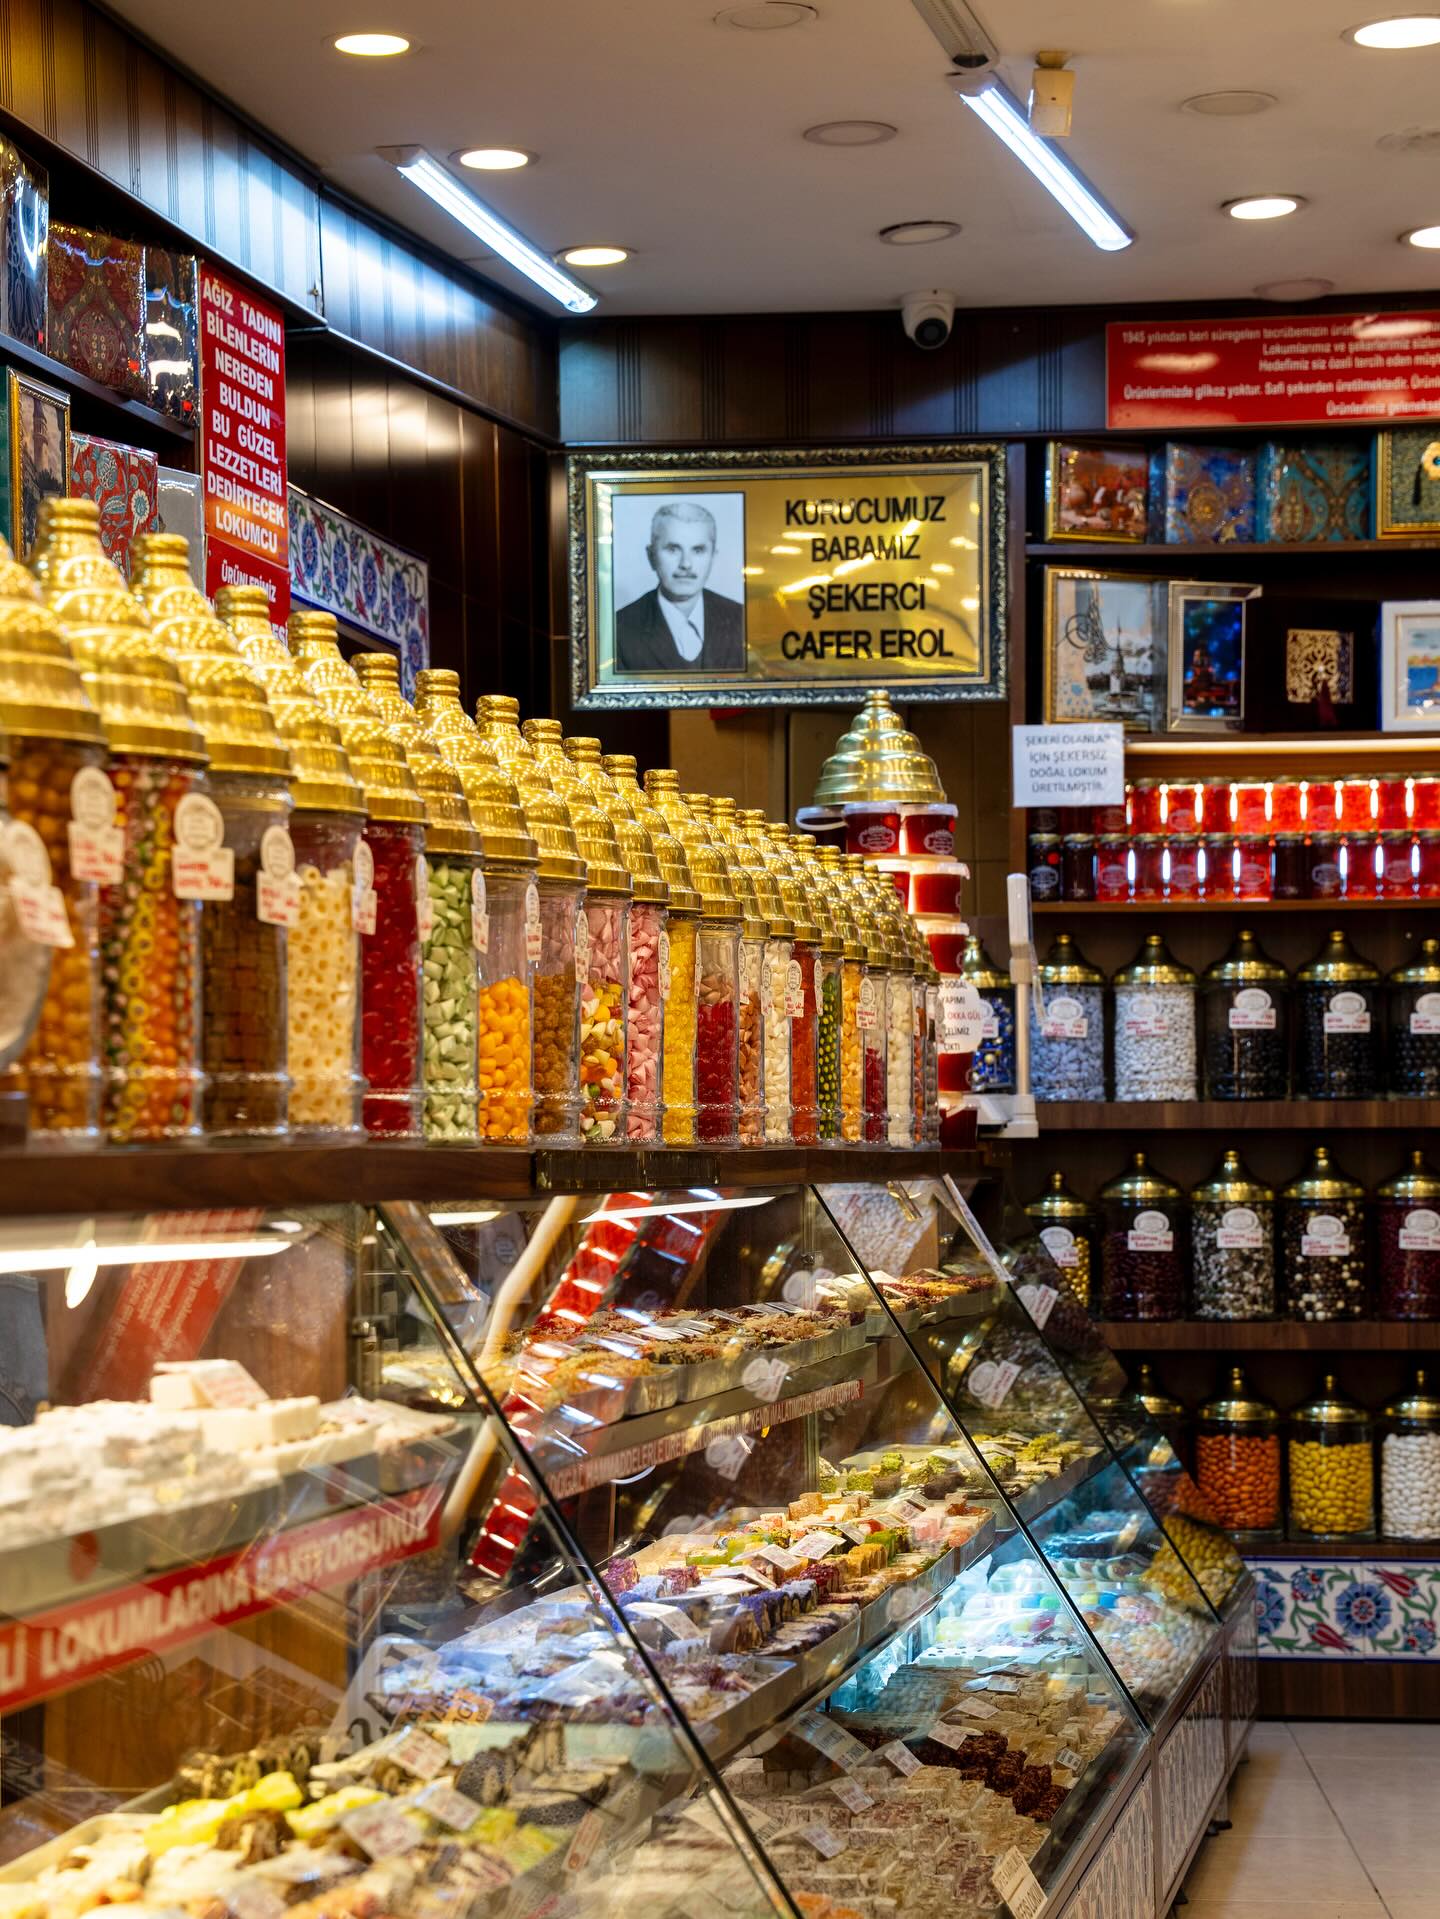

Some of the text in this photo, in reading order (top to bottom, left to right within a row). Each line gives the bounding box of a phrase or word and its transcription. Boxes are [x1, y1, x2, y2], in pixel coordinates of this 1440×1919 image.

[203, 277, 281, 346] AĞIZ TADINI
[206, 310, 280, 375] BİLENLERİN
[215, 347, 273, 401] NEREDEN
[220, 381, 271, 430] BULDUN
[212, 409, 279, 464] BU GÜZEL
[208, 438, 282, 497] LEZZETLERİ
[207, 470, 286, 528] DEDİRTECEK
[785, 496, 946, 526] KURUCUMUZ
[215, 505, 278, 553] LOKUMCU
[811, 534, 920, 562] BABAMIZ
[808, 575, 926, 619] ŞEKERCİ
[781, 628, 954, 660] CAFER EROL
[1029, 750, 1050, 764] İÇİN
[1030, 766, 1107, 778] DOĞAL LOKUM
[41, 1564, 251, 1680] LOKUMLARINA
